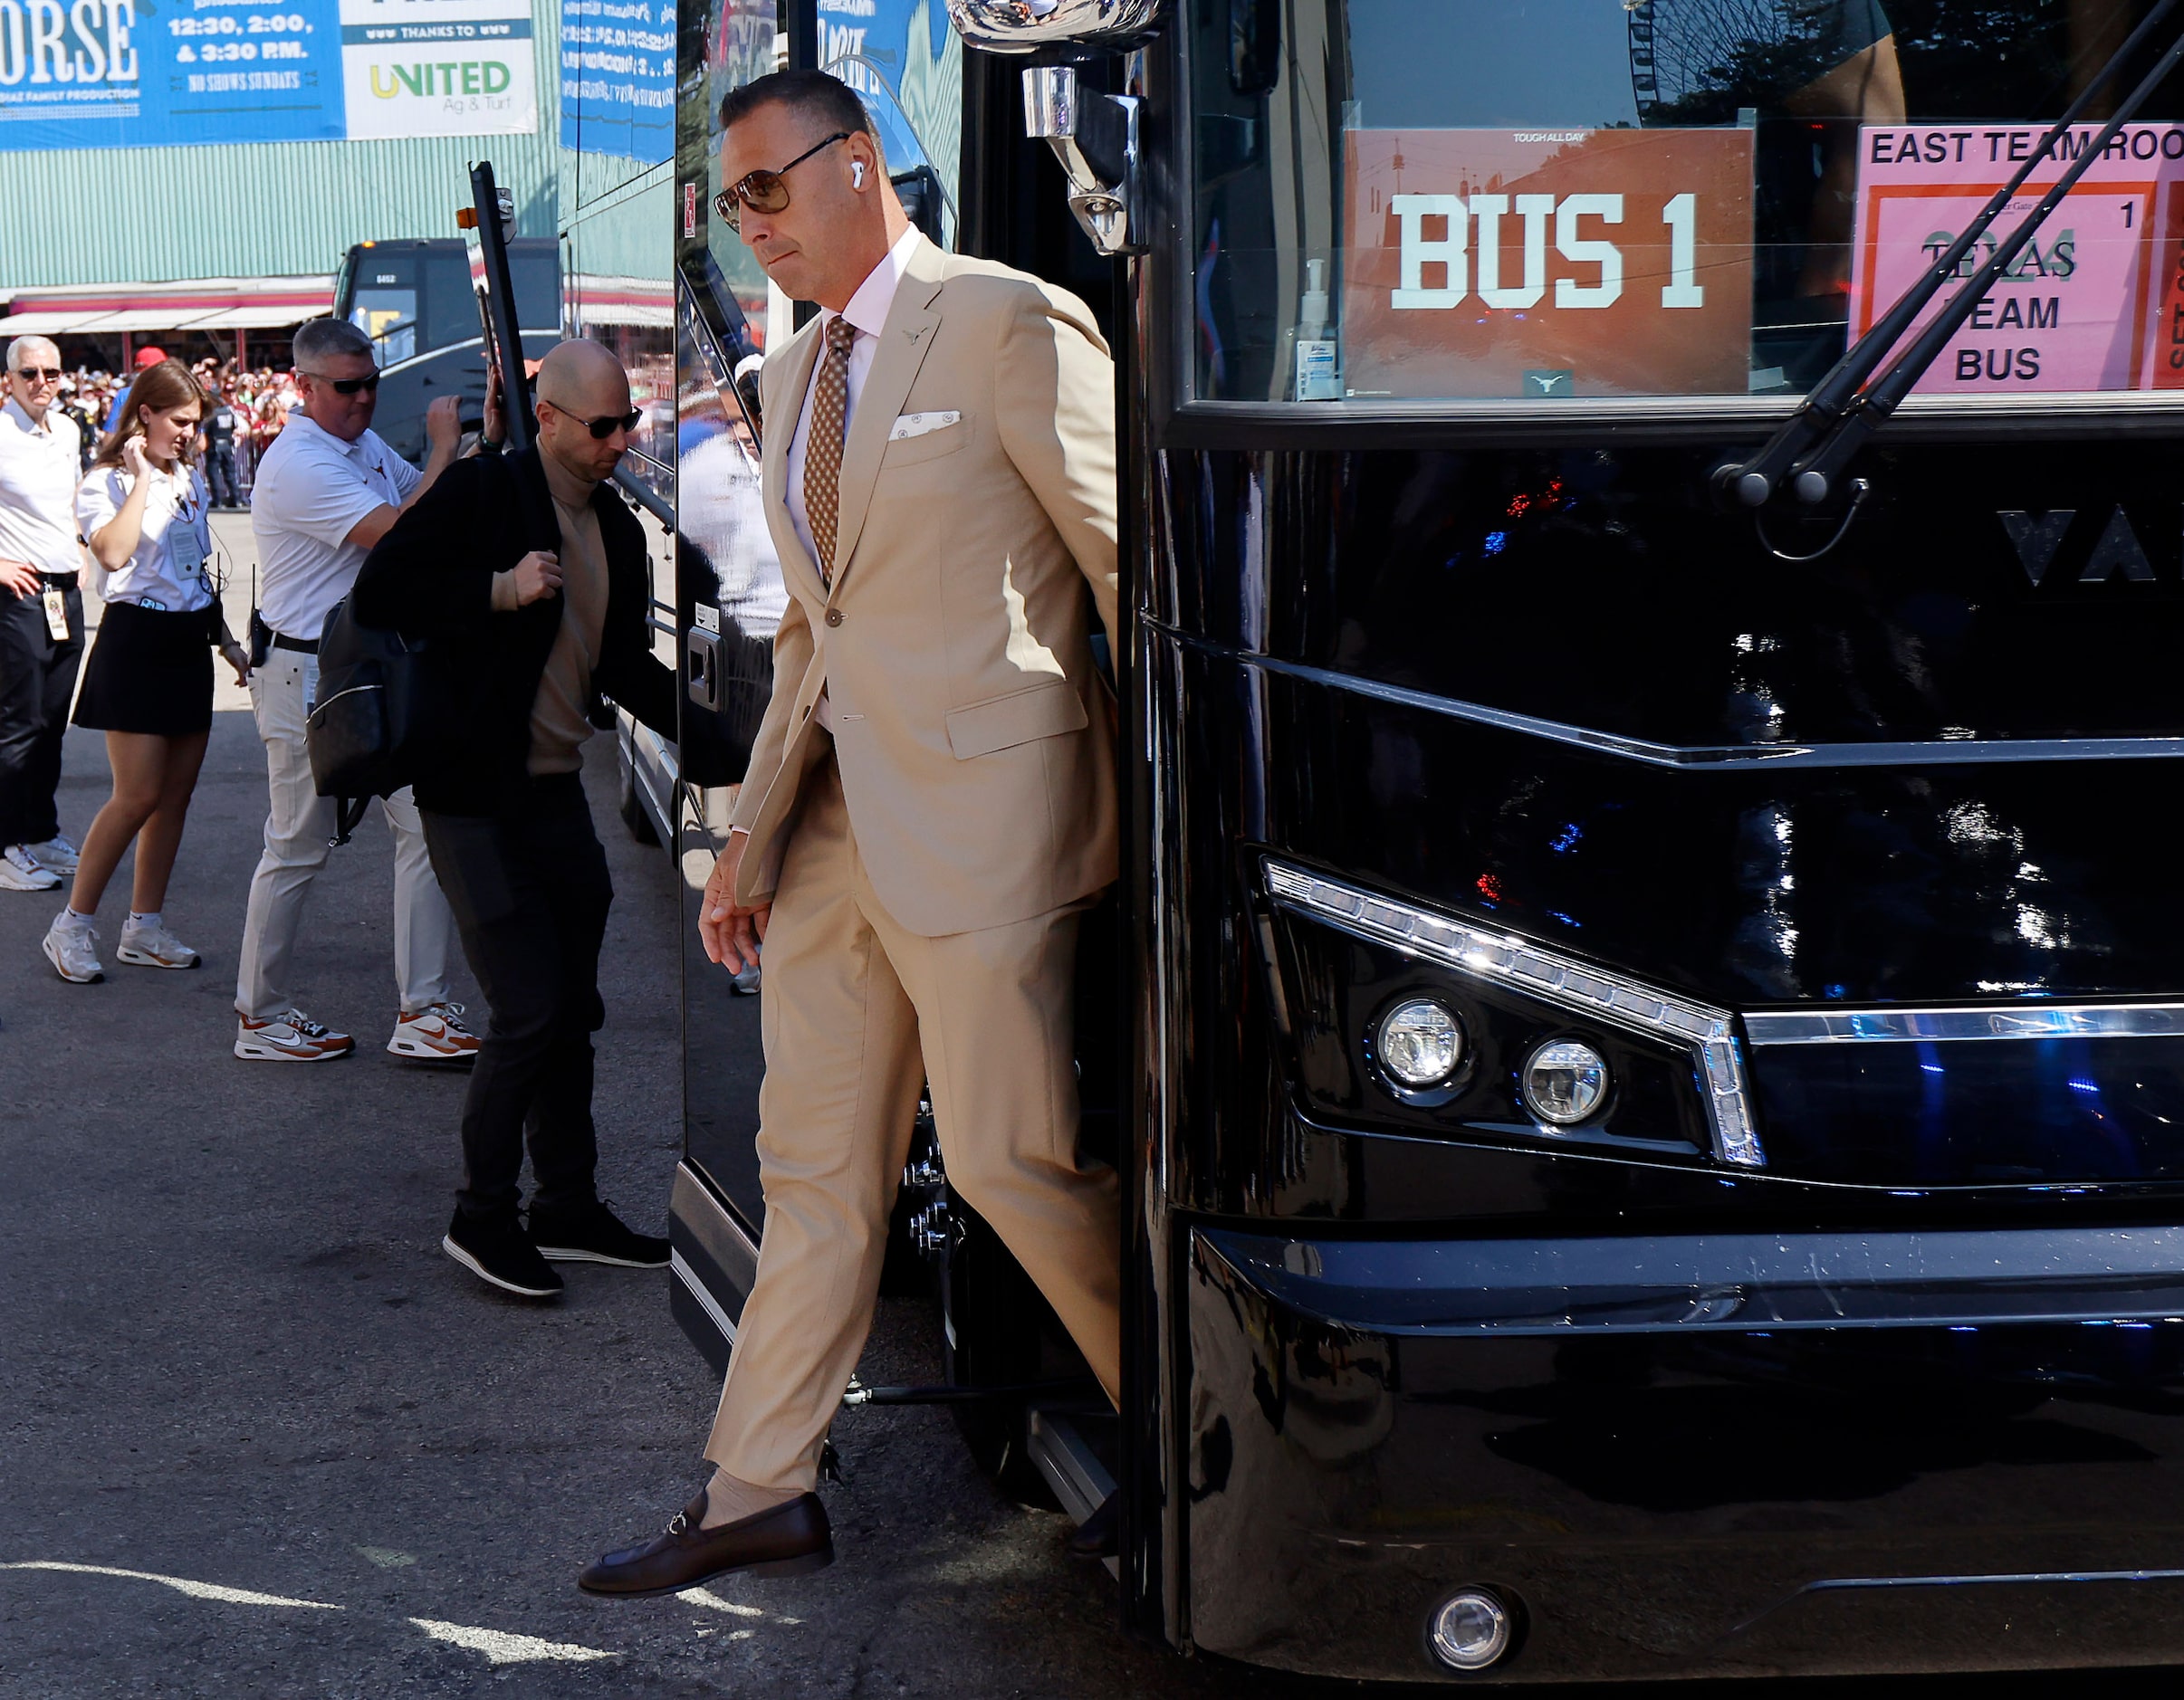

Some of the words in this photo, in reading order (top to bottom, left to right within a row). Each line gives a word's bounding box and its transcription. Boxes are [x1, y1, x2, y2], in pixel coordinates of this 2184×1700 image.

[168, 16, 244, 36] 12:30,
[247, 14, 313, 34] 2:00,
[401, 27, 453, 39] THANKS
[455, 25, 475, 37] TO
[0, 0, 139, 85] ORSE
[177, 44, 197, 62] &
[201, 43, 257, 62] 3:30
[262, 42, 309, 60] P.M.
[207, 72, 246, 91] SHOWS
[248, 72, 301, 90] SUNDAYS
[370, 61, 511, 99] UNITED
[443, 99, 464, 114] Ag
[468, 97, 480, 110] &
[484, 96, 512, 110] Turf
[1513, 133, 1547, 142] TOUGH
[1547, 133, 1565, 142] ALL
[1565, 132, 1585, 141] DAY
[1871, 132, 1972, 163] EAST
[2120, 201, 2133, 228] 1
[1391, 193, 1624, 310] BUS
[1662, 193, 1704, 309] 1
[1944, 297, 2059, 329] EAM
[1955, 348, 2040, 380] BUS
